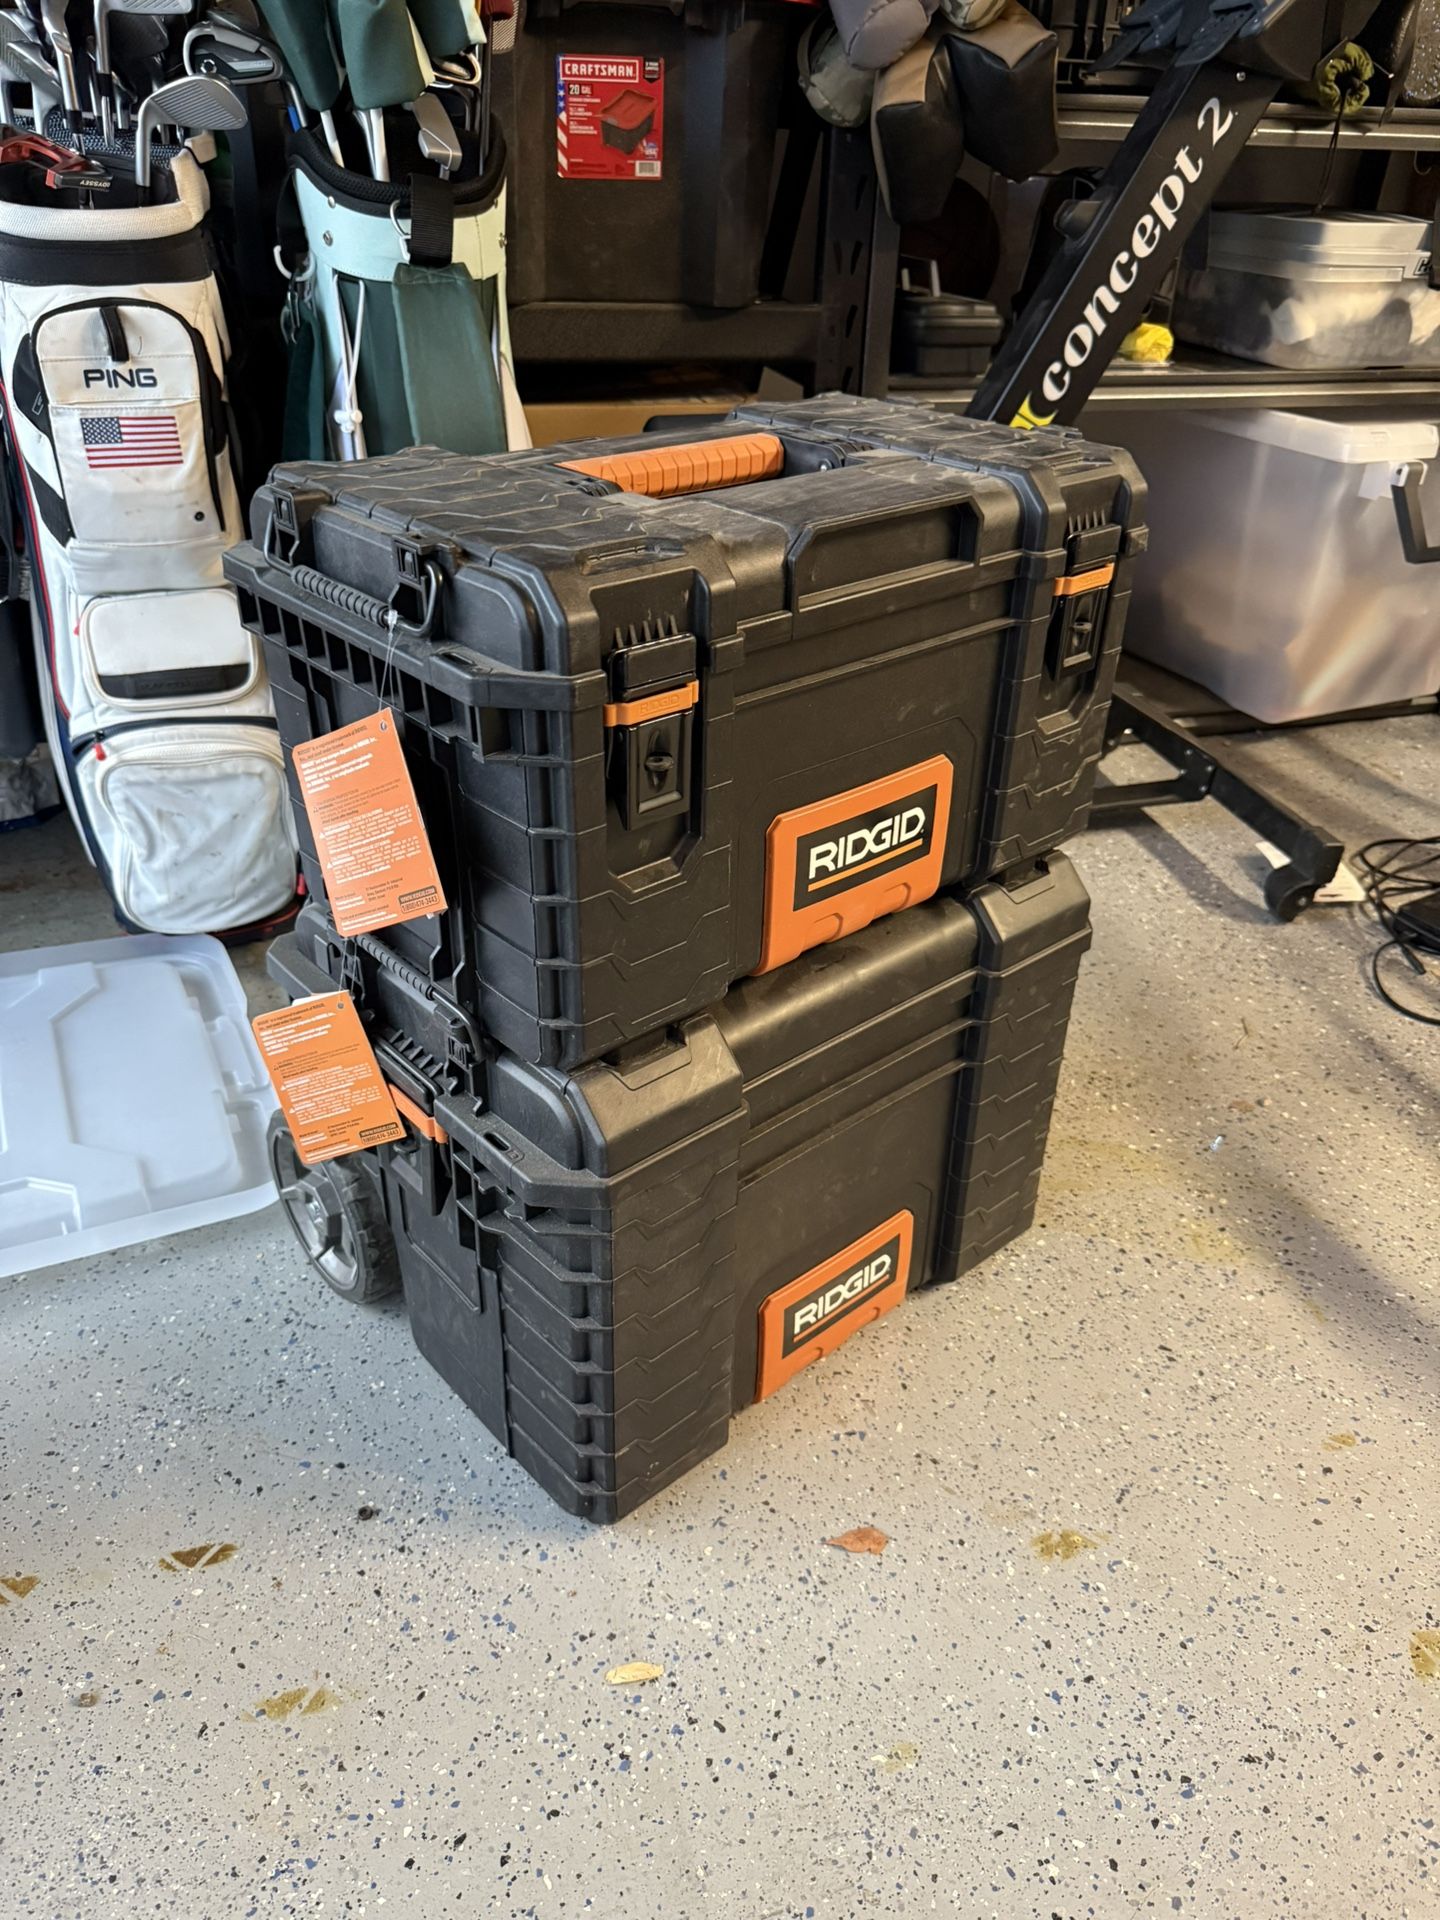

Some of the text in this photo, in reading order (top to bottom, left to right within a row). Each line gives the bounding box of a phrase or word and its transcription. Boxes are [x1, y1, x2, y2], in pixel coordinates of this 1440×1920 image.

[564, 63, 634, 77] CRAFTSMAN
[569, 84, 580, 95] 20
[80, 179, 111, 188] ODYSSEY
[1042, 97, 1233, 401] concept 2
[83, 368, 158, 389] PING
[808, 806, 926, 880] RIDGID
[793, 1253, 892, 1335] RIDGID
